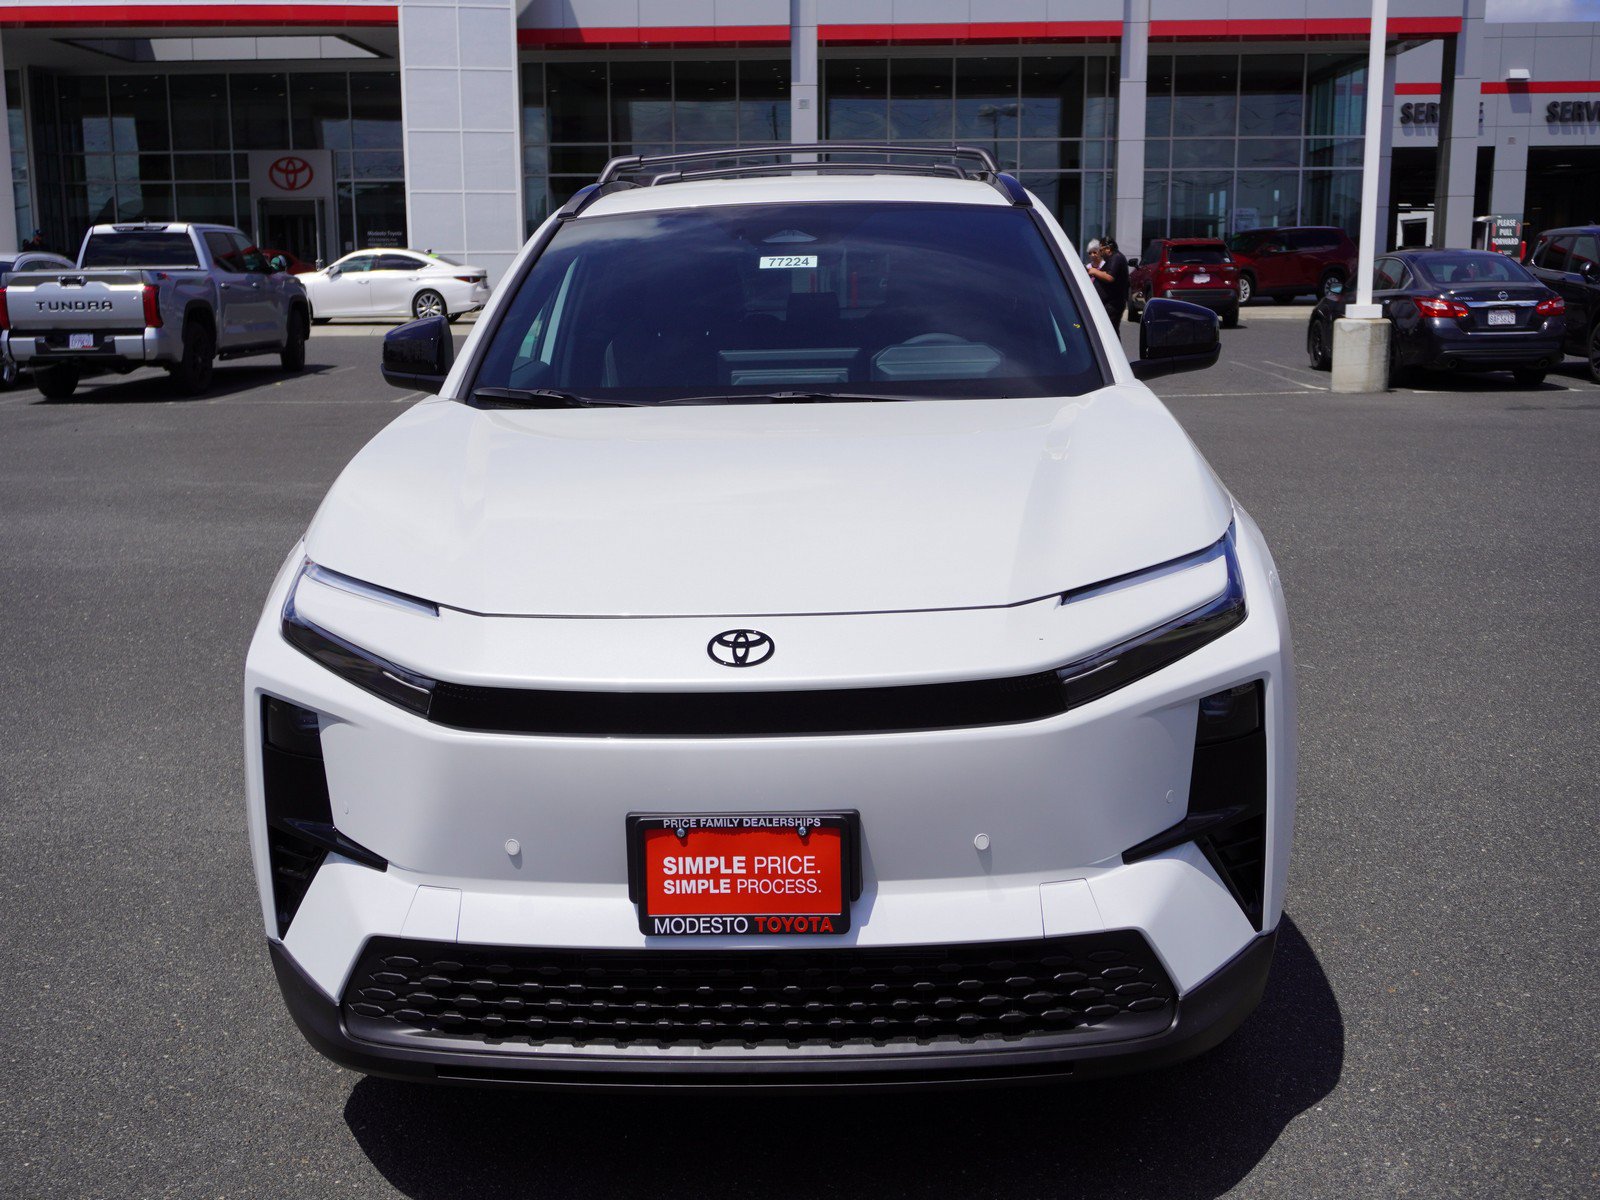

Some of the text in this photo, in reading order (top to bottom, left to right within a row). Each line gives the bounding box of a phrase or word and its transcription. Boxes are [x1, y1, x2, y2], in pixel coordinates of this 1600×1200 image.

[1497, 219, 1516, 227] PLEASE
[1499, 228, 1513, 236] PULL
[768, 257, 810, 267] 77224
[36, 301, 113, 312] TUNDRA
[663, 817, 821, 828] PRICE FAMILY DEALERSHIPS
[663, 855, 821, 874] SIMPLE PRICE.
[663, 879, 822, 894] SIMPLE PROCESS.
[654, 916, 834, 934] MODESTO TOYOTA
